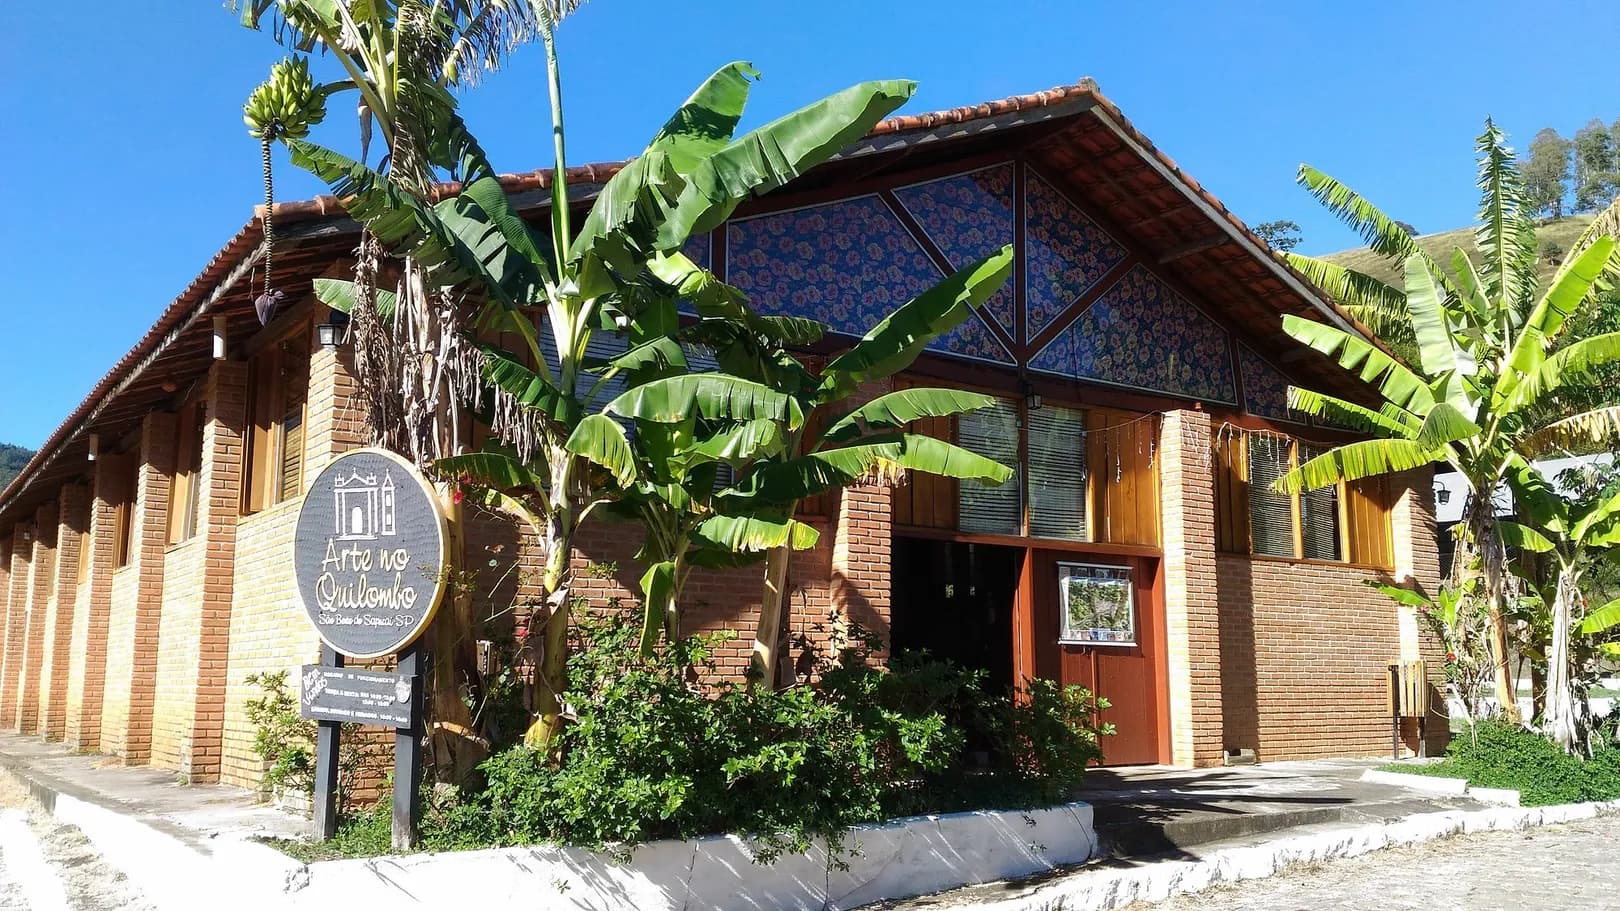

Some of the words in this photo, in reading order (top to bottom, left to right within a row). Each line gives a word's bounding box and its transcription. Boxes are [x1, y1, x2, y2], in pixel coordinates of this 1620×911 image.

[321, 537, 373, 572] Arte
[380, 547, 411, 572] no
[315, 571, 418, 612] Quilombo
[395, 614, 414, 627] SP
